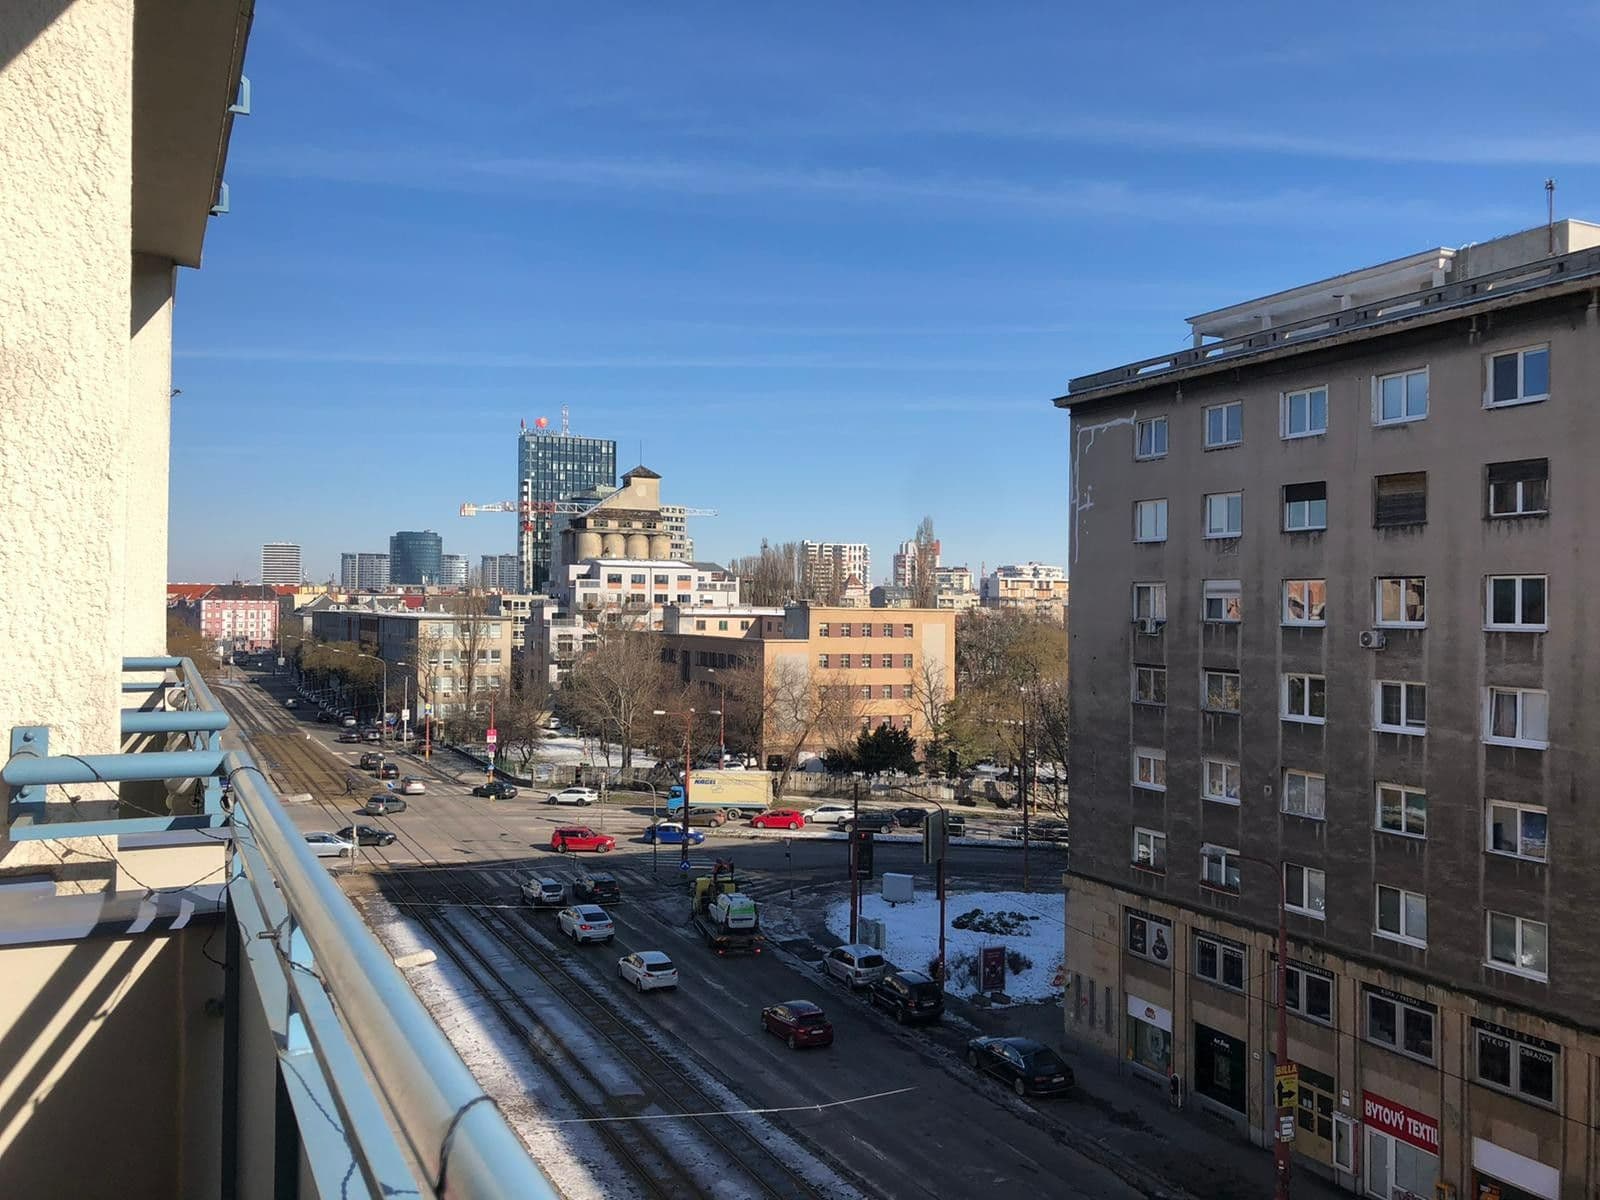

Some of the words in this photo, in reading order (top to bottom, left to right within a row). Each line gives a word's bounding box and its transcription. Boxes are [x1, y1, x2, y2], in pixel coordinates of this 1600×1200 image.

[1275, 1064, 1298, 1075] BILLA
[1365, 1099, 1405, 1131] BYTOVÝ
[1406, 1116, 1439, 1146] TEXTIL
